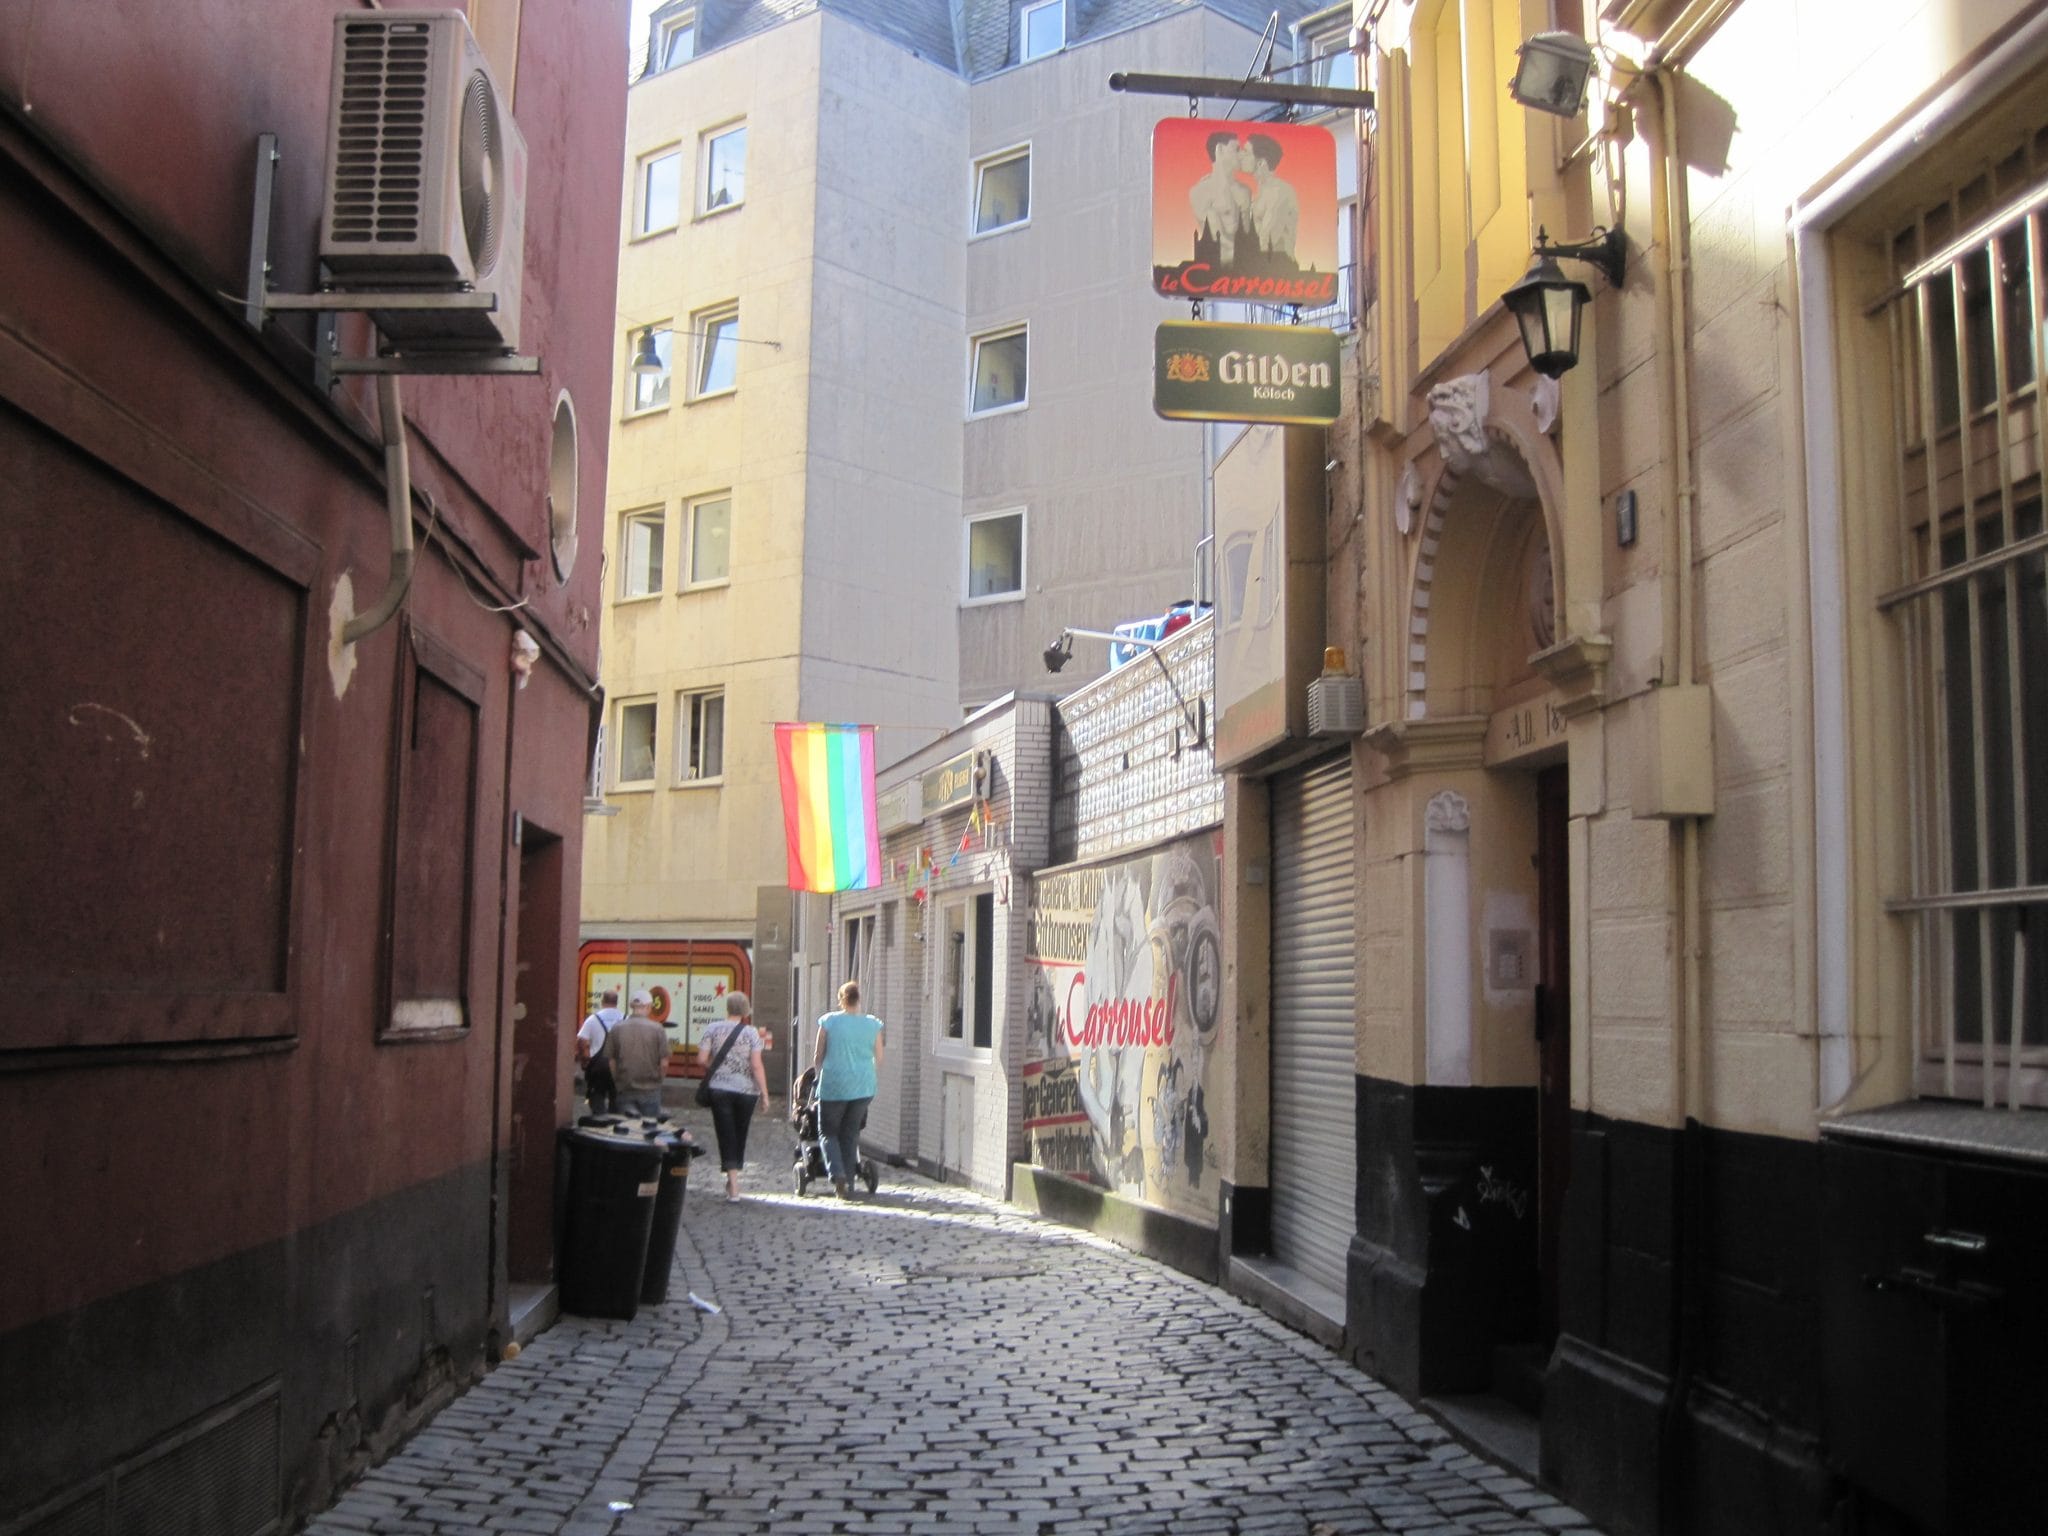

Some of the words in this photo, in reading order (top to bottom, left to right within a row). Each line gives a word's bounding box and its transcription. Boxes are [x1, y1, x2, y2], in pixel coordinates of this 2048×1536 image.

[1180, 263, 1333, 298] Carrousel
[1219, 351, 1331, 388] Gilden
[1253, 386, 1295, 401] Kölsch
[692, 1005, 714, 1013] GAMES
[1067, 971, 1176, 1049] Carrousel
